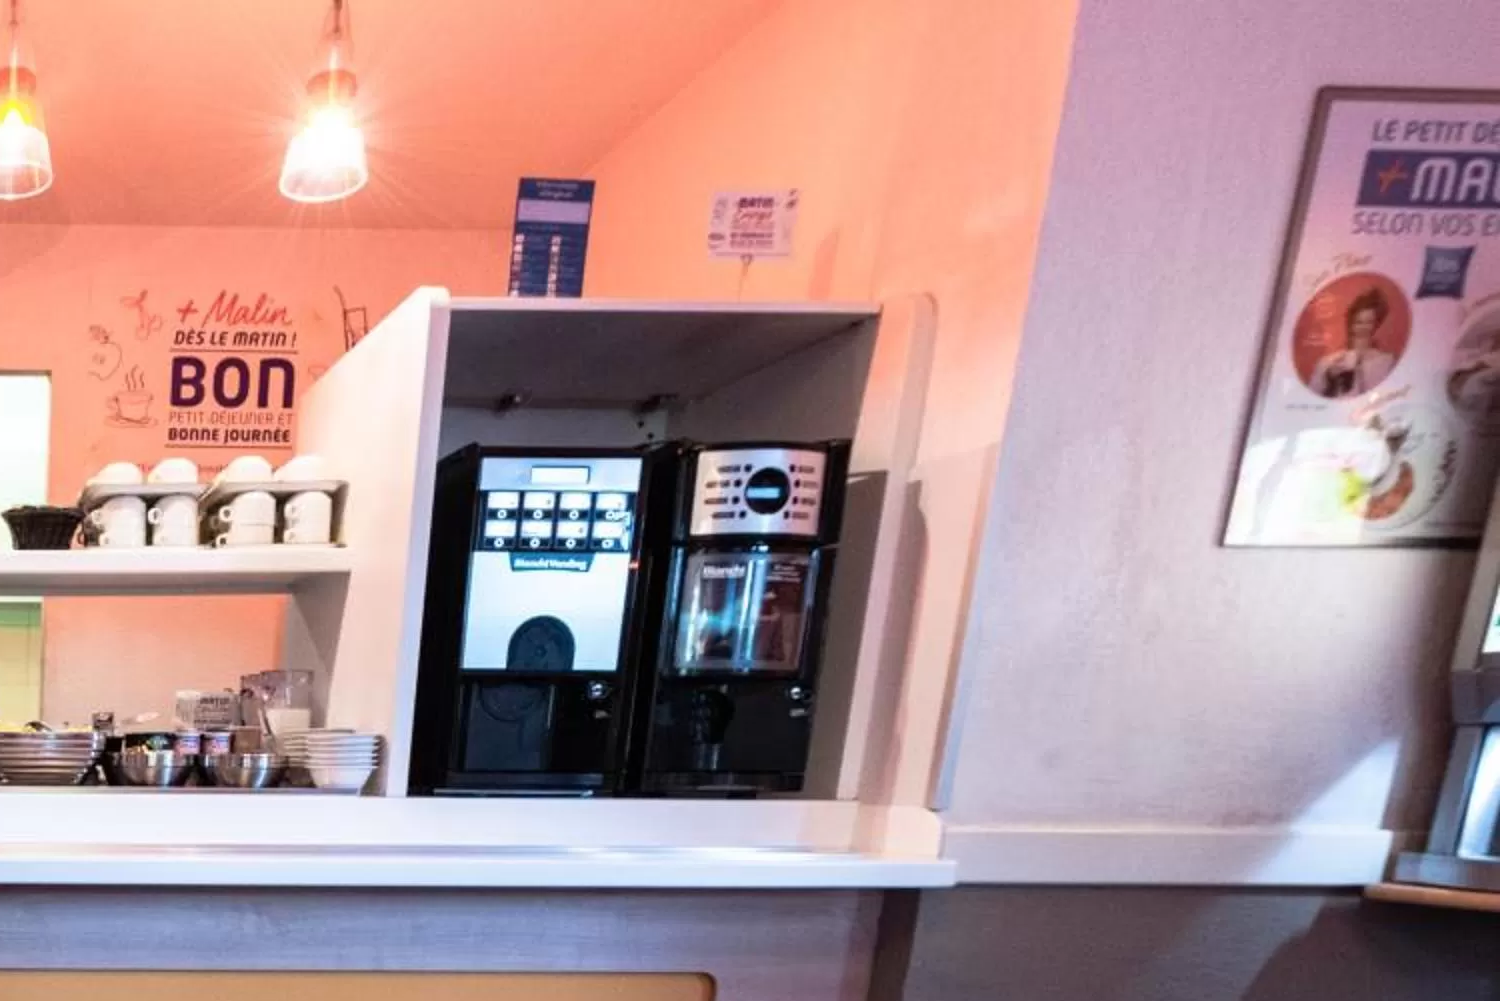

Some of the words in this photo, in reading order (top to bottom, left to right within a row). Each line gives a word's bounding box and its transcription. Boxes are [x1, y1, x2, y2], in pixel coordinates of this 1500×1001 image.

[1372, 119, 1398, 142] LE
[1403, 119, 1468, 143] PETIT
[1352, 212, 1423, 234] SELON
[1430, 213, 1477, 236] VOS
[201, 288, 293, 328] Malin
[210, 331, 229, 346] LE
[232, 332, 287, 348] MATIN
[169, 355, 296, 409] BON
[169, 410, 205, 424] PETIT
[278, 412, 294, 425] ET
[168, 427, 220, 442] BONNE
[222, 425, 291, 444] JOURNÉE
